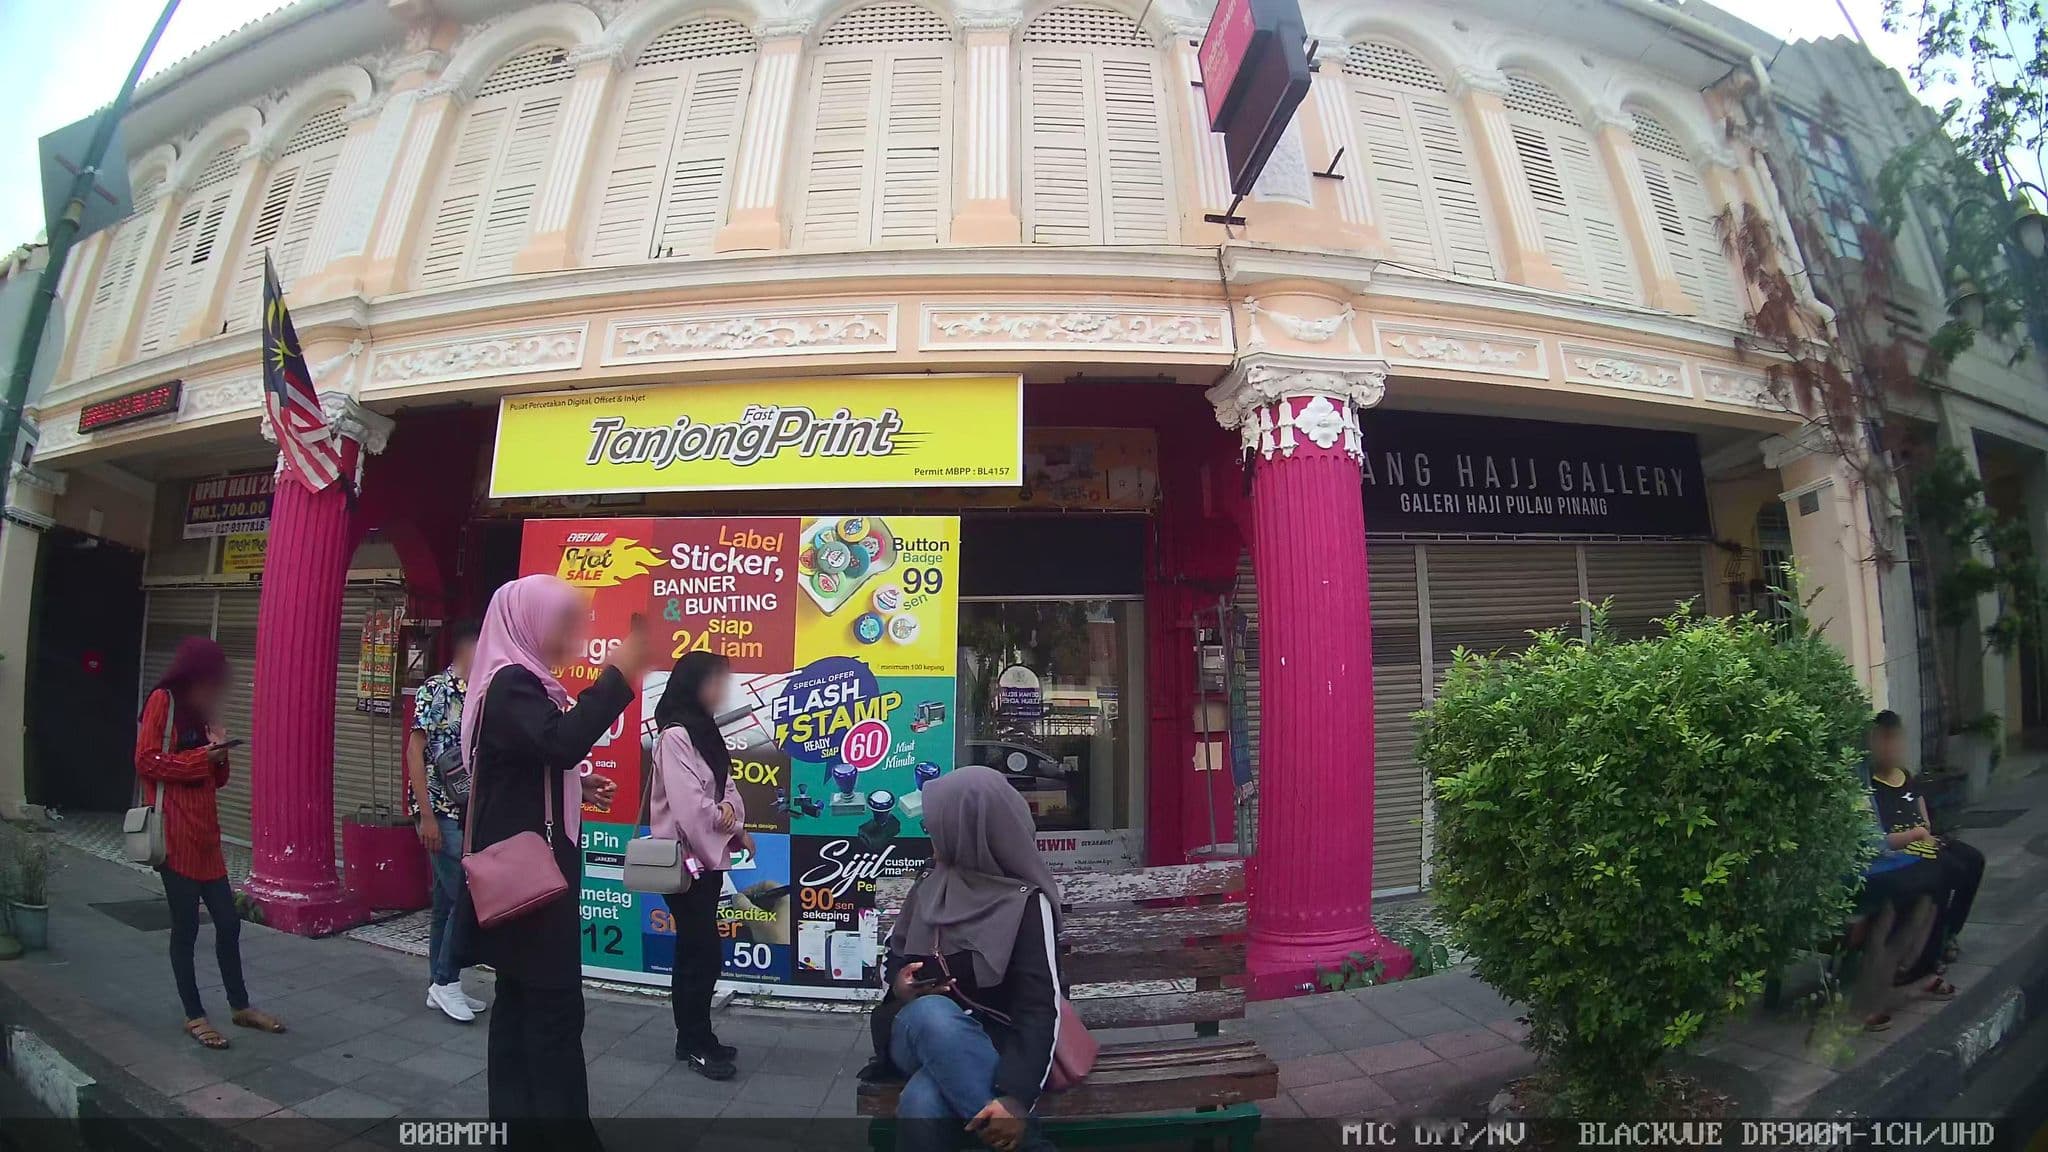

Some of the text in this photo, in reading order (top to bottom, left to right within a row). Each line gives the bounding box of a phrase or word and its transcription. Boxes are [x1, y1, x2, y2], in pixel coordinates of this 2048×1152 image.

[510, 403, 528, 411] Pusat
[529, 400, 566, 410] Percetakan
[593, 396, 616, 404] Offset
[616, 395, 623, 403] &
[624, 394, 646, 403] Inkjet
[743, 407, 775, 421] Fast
[914, 467, 943, 476] Permit
[945, 467, 971, 476] MBPP
[977, 467, 1010, 476] BL4157
[1456, 454, 1537, 490] HAJJ
[1559, 459, 1685, 498] GALLERY
[228, 476, 258, 497] HAJI
[1400, 493, 1608, 516] GALERI HAJI PULAU PINANG
[719, 525, 783, 552] Label
[892, 537, 950, 552] Button
[566, 547, 613, 571] Hot
[670, 543, 784, 582] Sticker,
[903, 552, 943, 565] Badge
[566, 570, 603, 580] SALE
[903, 567, 943, 595] 99
[653, 576, 735, 596] BANNER
[663, 593, 777, 622] & BUNTING
[903, 594, 928, 611] sen
[708, 615, 753, 639] siap
[671, 630, 713, 659] 24
[570, 666, 585, 678] 10
[793, 670, 855, 690] SPECIAL OFFER
[772, 678, 862, 720] FLASH
[791, 691, 903, 743] STAMP
[804, 737, 830, 753] READY
[821, 746, 840, 759] SIAP
[850, 729, 883, 762] 60
[595, 759, 617, 769] each
[882, 753, 916, 771] Minute
[730, 758, 780, 787] BOX
[593, 831, 619, 849] Pin
[800, 839, 896, 898] Sijil
[885, 857, 925, 868] custom
[579, 887, 632, 908] metag
[800, 887, 855, 911] 90 sen
[716, 905, 777, 922] Roadtax
[803, 910, 850, 921] sekeping
[583, 922, 624, 956] 12
